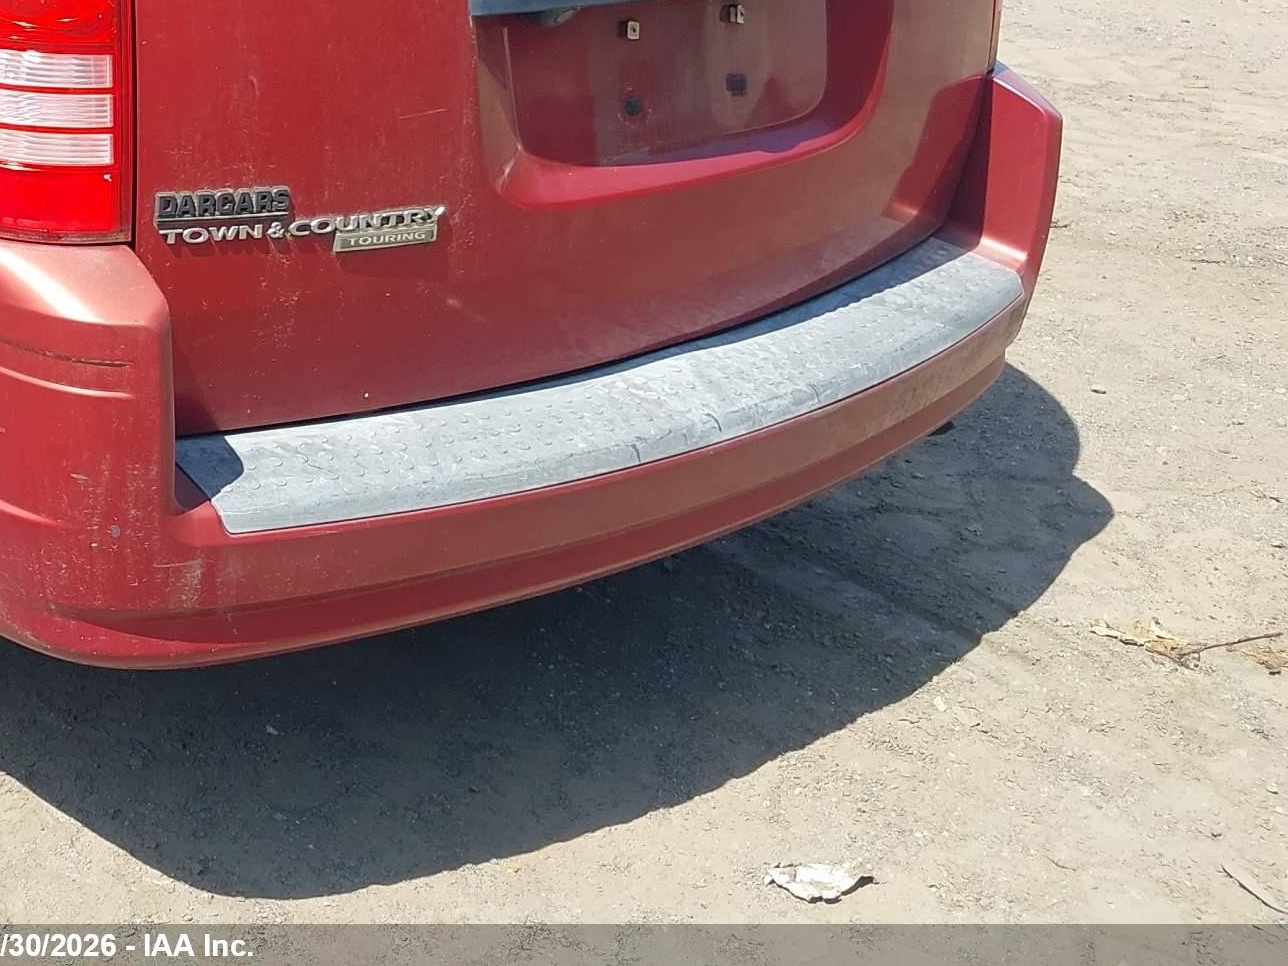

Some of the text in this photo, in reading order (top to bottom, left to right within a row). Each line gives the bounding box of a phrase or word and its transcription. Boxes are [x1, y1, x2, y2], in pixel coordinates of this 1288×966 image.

[156, 186, 291, 219] DARCARS
[159, 224, 263, 245] TOWN
[287, 206, 447, 236] COUNTRY
[348, 229, 427, 247] TOURING
